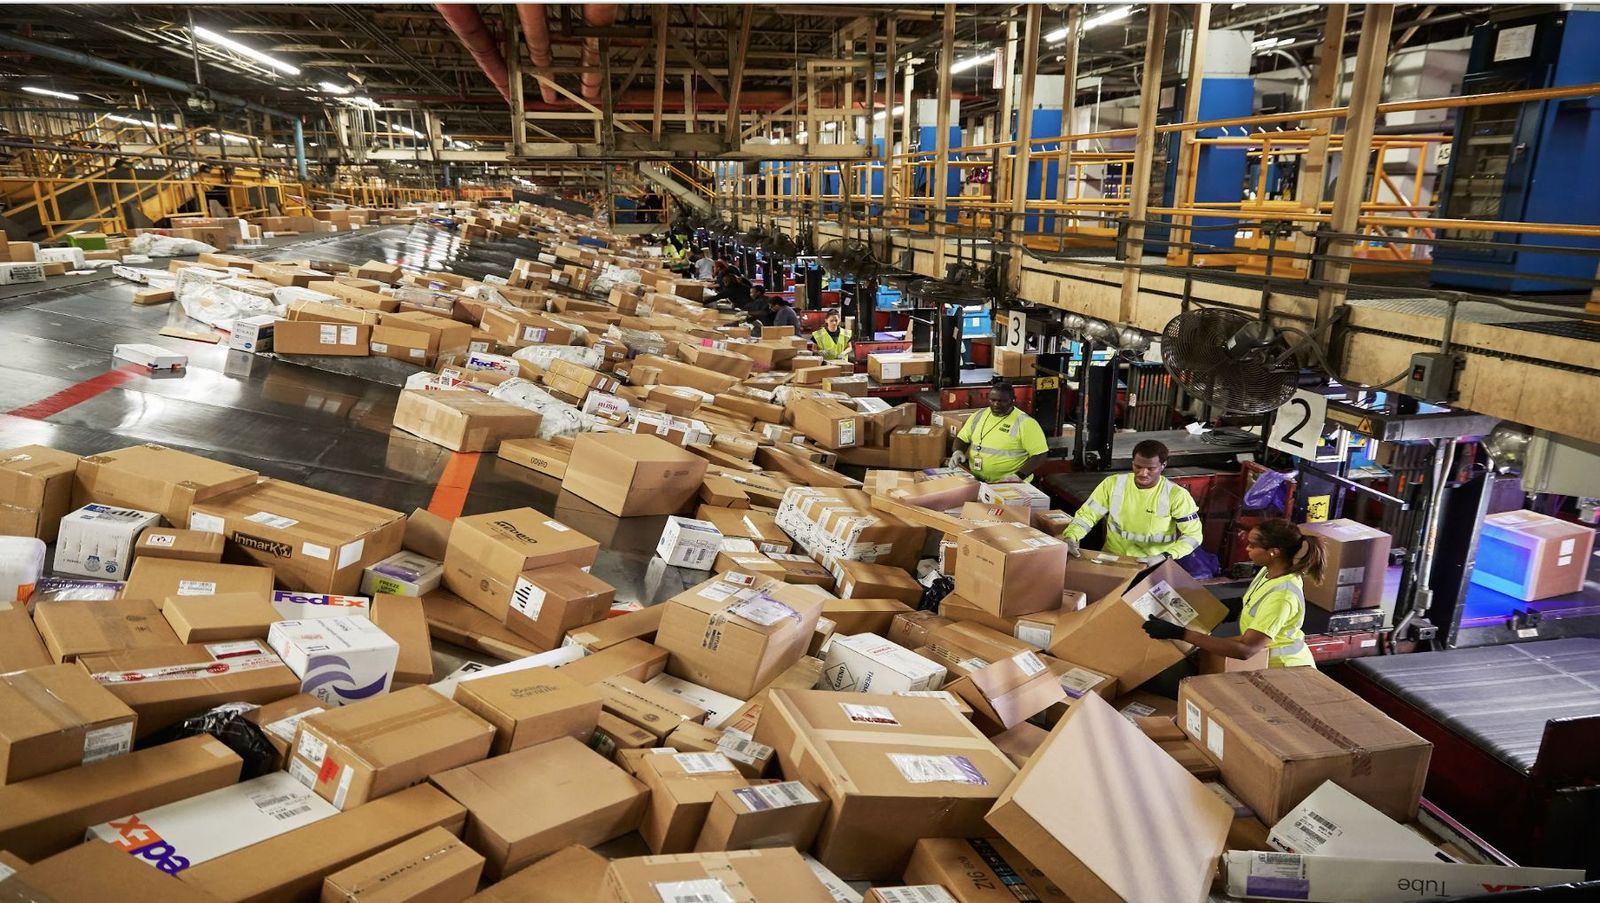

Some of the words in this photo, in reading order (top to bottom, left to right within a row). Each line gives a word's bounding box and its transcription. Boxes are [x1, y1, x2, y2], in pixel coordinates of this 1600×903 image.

[1010, 316, 1021, 347] 3
[470, 357, 507, 371] FedEx
[1281, 397, 1312, 448] 2
[235, 531, 280, 553] Inmark
[274, 591, 366, 609] FedEx
[1397, 878, 1450, 897] Tube
